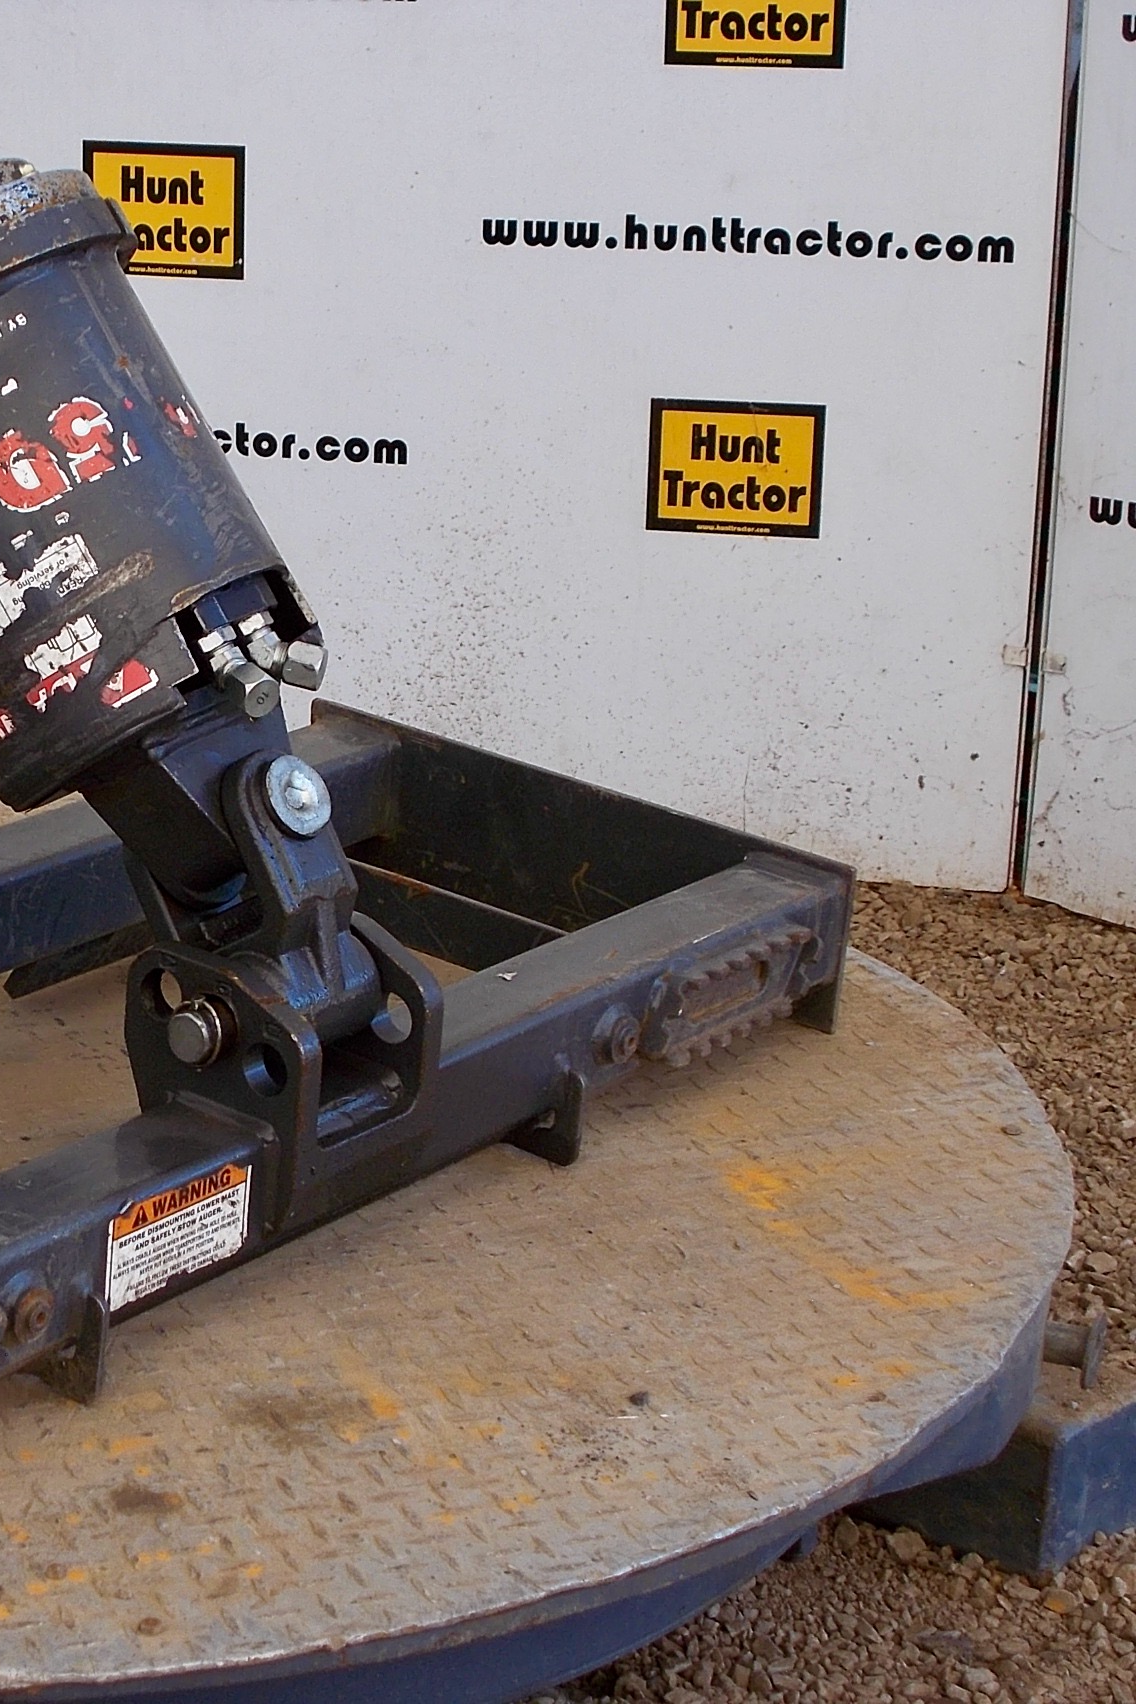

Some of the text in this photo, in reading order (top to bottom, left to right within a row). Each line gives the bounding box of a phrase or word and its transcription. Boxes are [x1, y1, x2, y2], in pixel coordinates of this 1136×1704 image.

[681, 1, 829, 42] Tractor
[121, 165, 204, 205] Hunt
[481, 215, 1015, 264] www.hunttractor.com
[691, 423, 781, 464] Hunt
[663, 470, 807, 513] Tractor
[16, 564, 56, 591] servicing
[54, 559, 66, 568] or
[153, 1168, 231, 1219] WARNING
[119, 1188, 239, 1248] BEFORE DISMOUNTING LOWER MAST
[135, 1238, 148, 1251] AND
[151, 1226, 175, 1244] SAFELY
[177, 1217, 196, 1231] STOW
